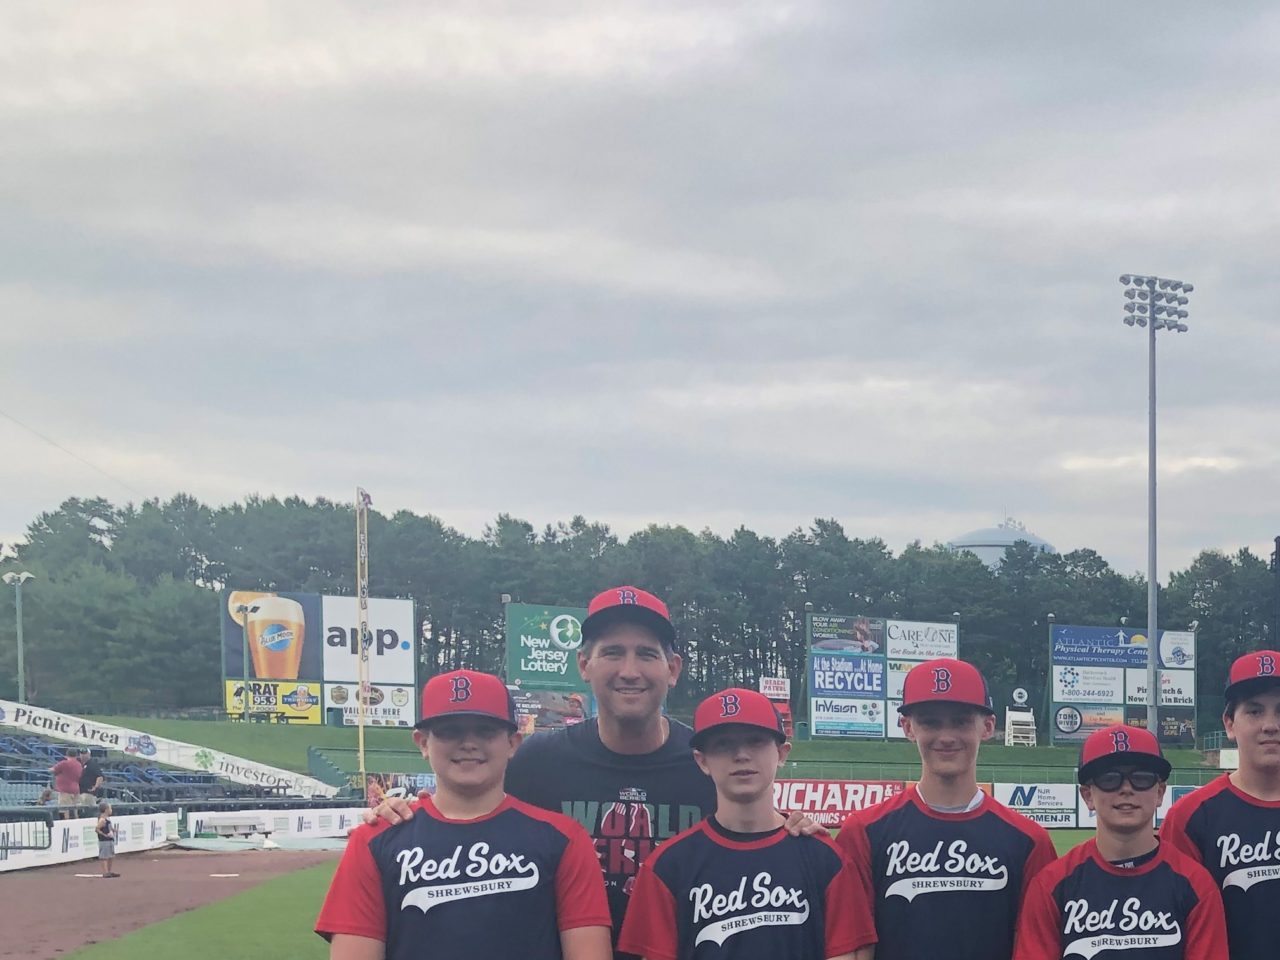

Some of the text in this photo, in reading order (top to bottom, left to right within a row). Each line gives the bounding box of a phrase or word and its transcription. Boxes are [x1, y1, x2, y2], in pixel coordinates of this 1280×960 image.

[520, 635, 550, 648] New
[1054, 644, 1125, 656] Physical Therapy
[1056, 638, 1114, 646] ATLANTIC
[527, 647, 568, 663] Jersey
[520, 659, 568, 675] Lottery
[813, 657, 883, 673] At the Stadium Home
[1256, 655, 1275, 676] B
[253, 683, 279, 696] RAT
[449, 675, 472, 703] B
[815, 671, 882, 691] RECYCLE
[932, 667, 952, 694] B
[254, 696, 276, 705] 95.9
[719, 694, 741, 717] B
[1128, 695, 1145, 703] Now
[383, 708, 401, 716] HERE
[13, 707, 119, 746] Picnic Area
[1110, 731, 1131, 753] B
[219, 757, 291, 788] investors
[886, 840, 999, 876] Red Sox
[1217, 831, 1272, 867] Red
[397, 842, 526, 886] Red Sox
[427, 881, 513, 898] SHREWSBURY
[912, 880, 984, 890] SHREWSBURY
[690, 872, 802, 923] Red Sox
[721, 914, 790, 933] SHREWSBURY
[1064, 898, 1174, 934] Red Sox
